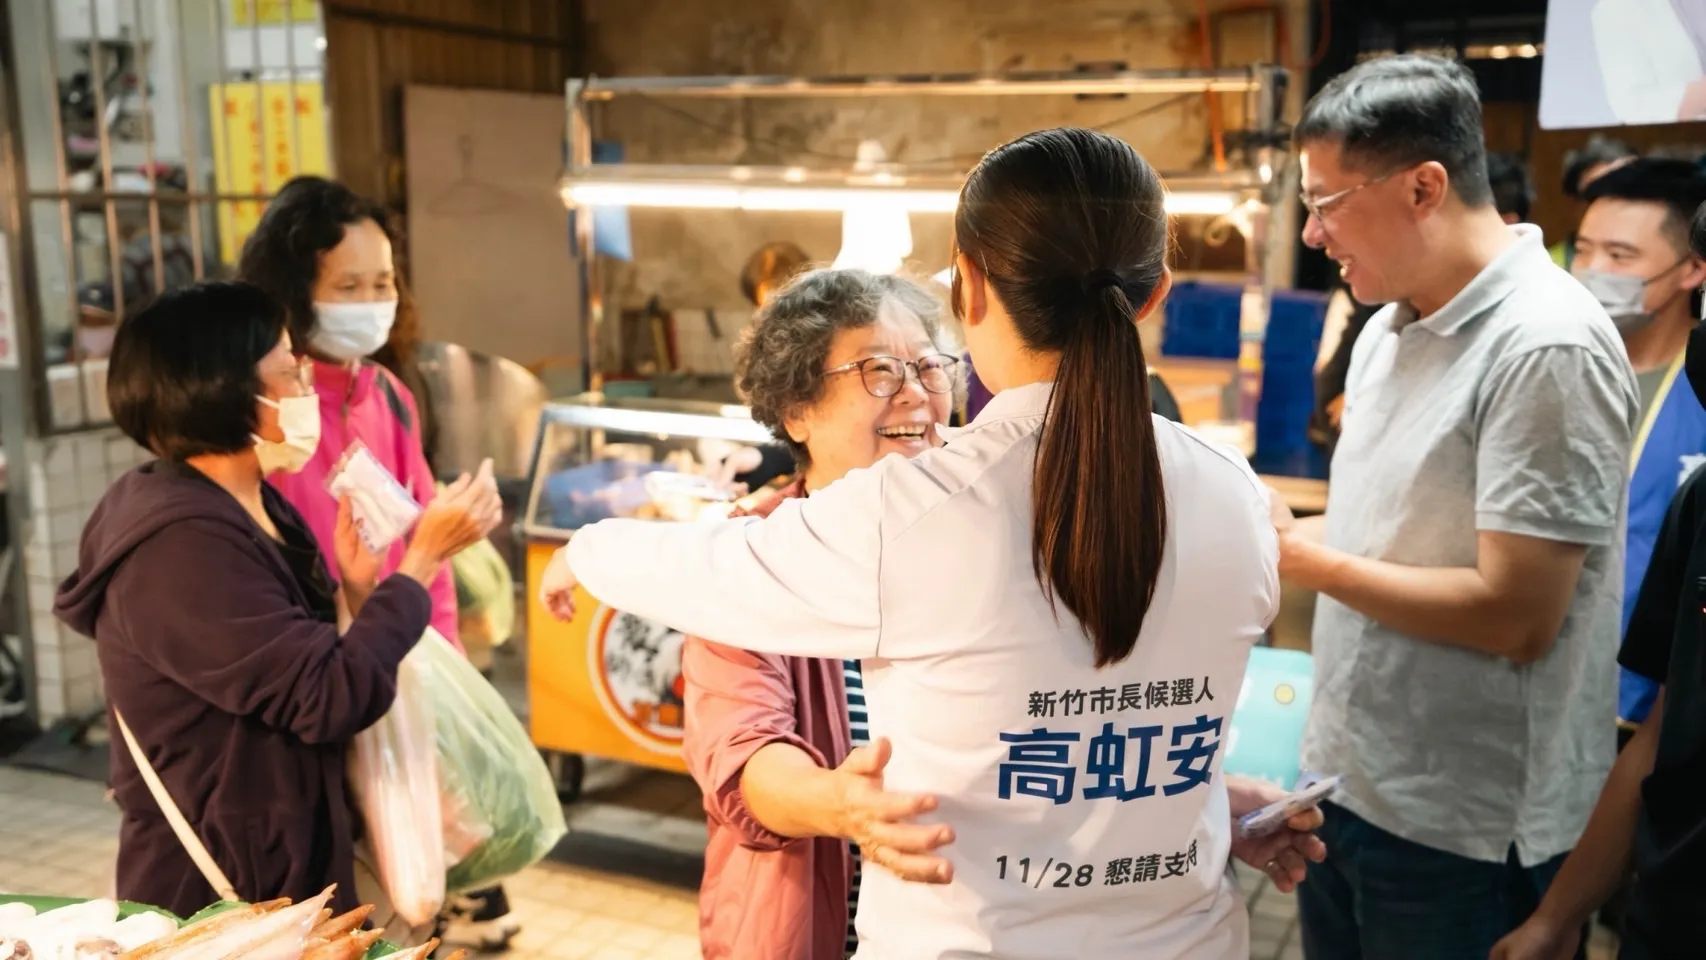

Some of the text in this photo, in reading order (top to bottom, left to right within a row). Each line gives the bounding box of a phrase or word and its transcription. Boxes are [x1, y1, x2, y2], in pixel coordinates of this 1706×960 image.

[1027, 676, 1215, 718] 新竹市長候選人
[997, 714, 1224, 805] 高虹安
[996, 855, 1094, 889] 11/28
